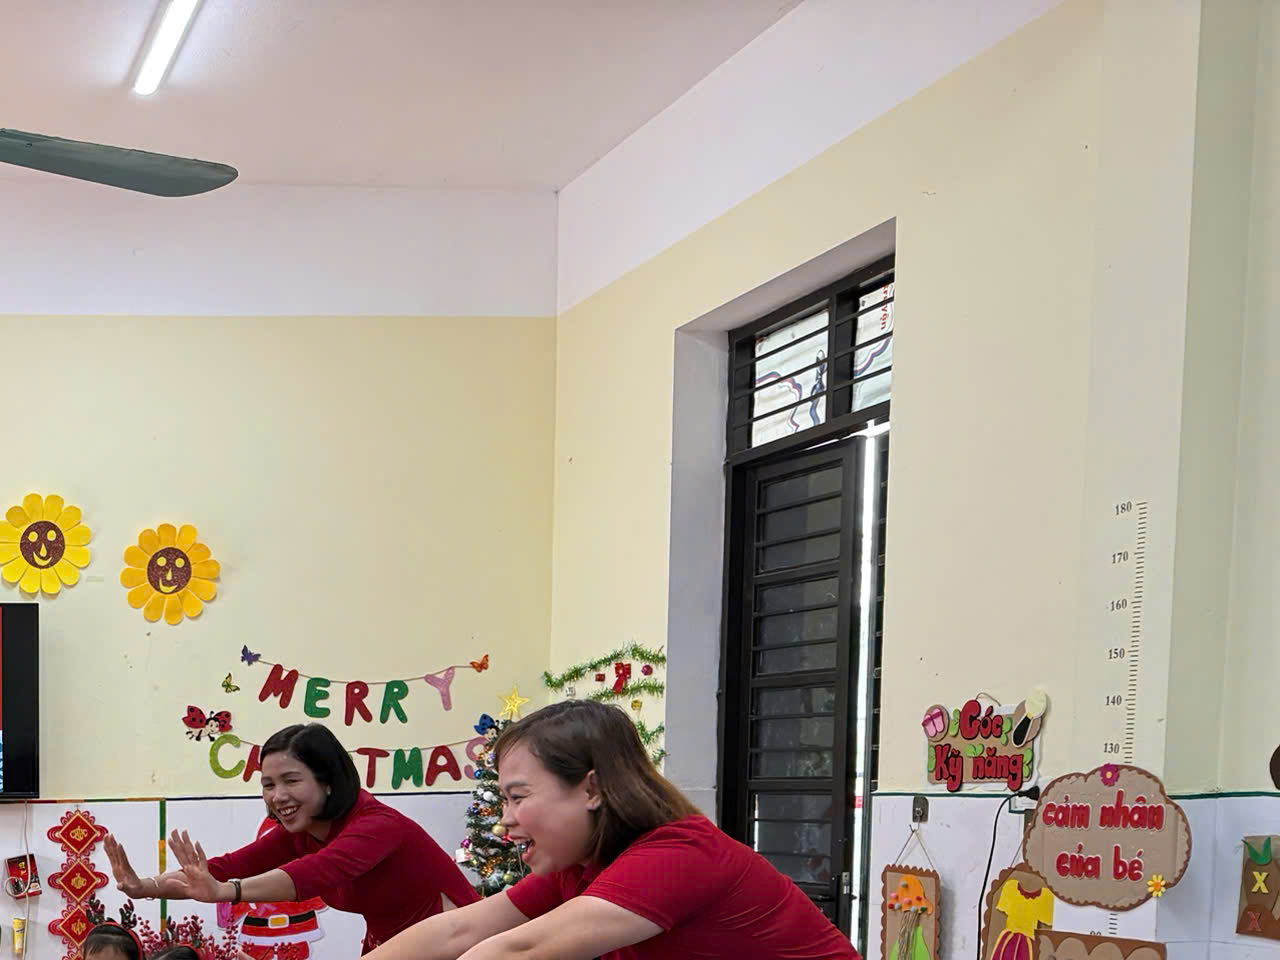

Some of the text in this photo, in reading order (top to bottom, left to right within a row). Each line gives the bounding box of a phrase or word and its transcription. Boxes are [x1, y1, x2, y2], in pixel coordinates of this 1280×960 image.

[1115, 502, 1132, 515] 180
[1111, 551, 1129, 564] 170
[1110, 599, 1128, 611] 160
[1108, 648, 1125, 659] 150
[258, 664, 456, 727] MERRY
[1105, 695, 1122, 706] 140
[959, 699, 1004, 740] Góc
[209, 733, 491, 790] CTMAS
[1103, 743, 1120, 754] 130
[934, 743, 1024, 793] Kỹ năng
[1042, 789, 1165, 831] cảm nhân
[1056, 842, 1144, 882] của bé
